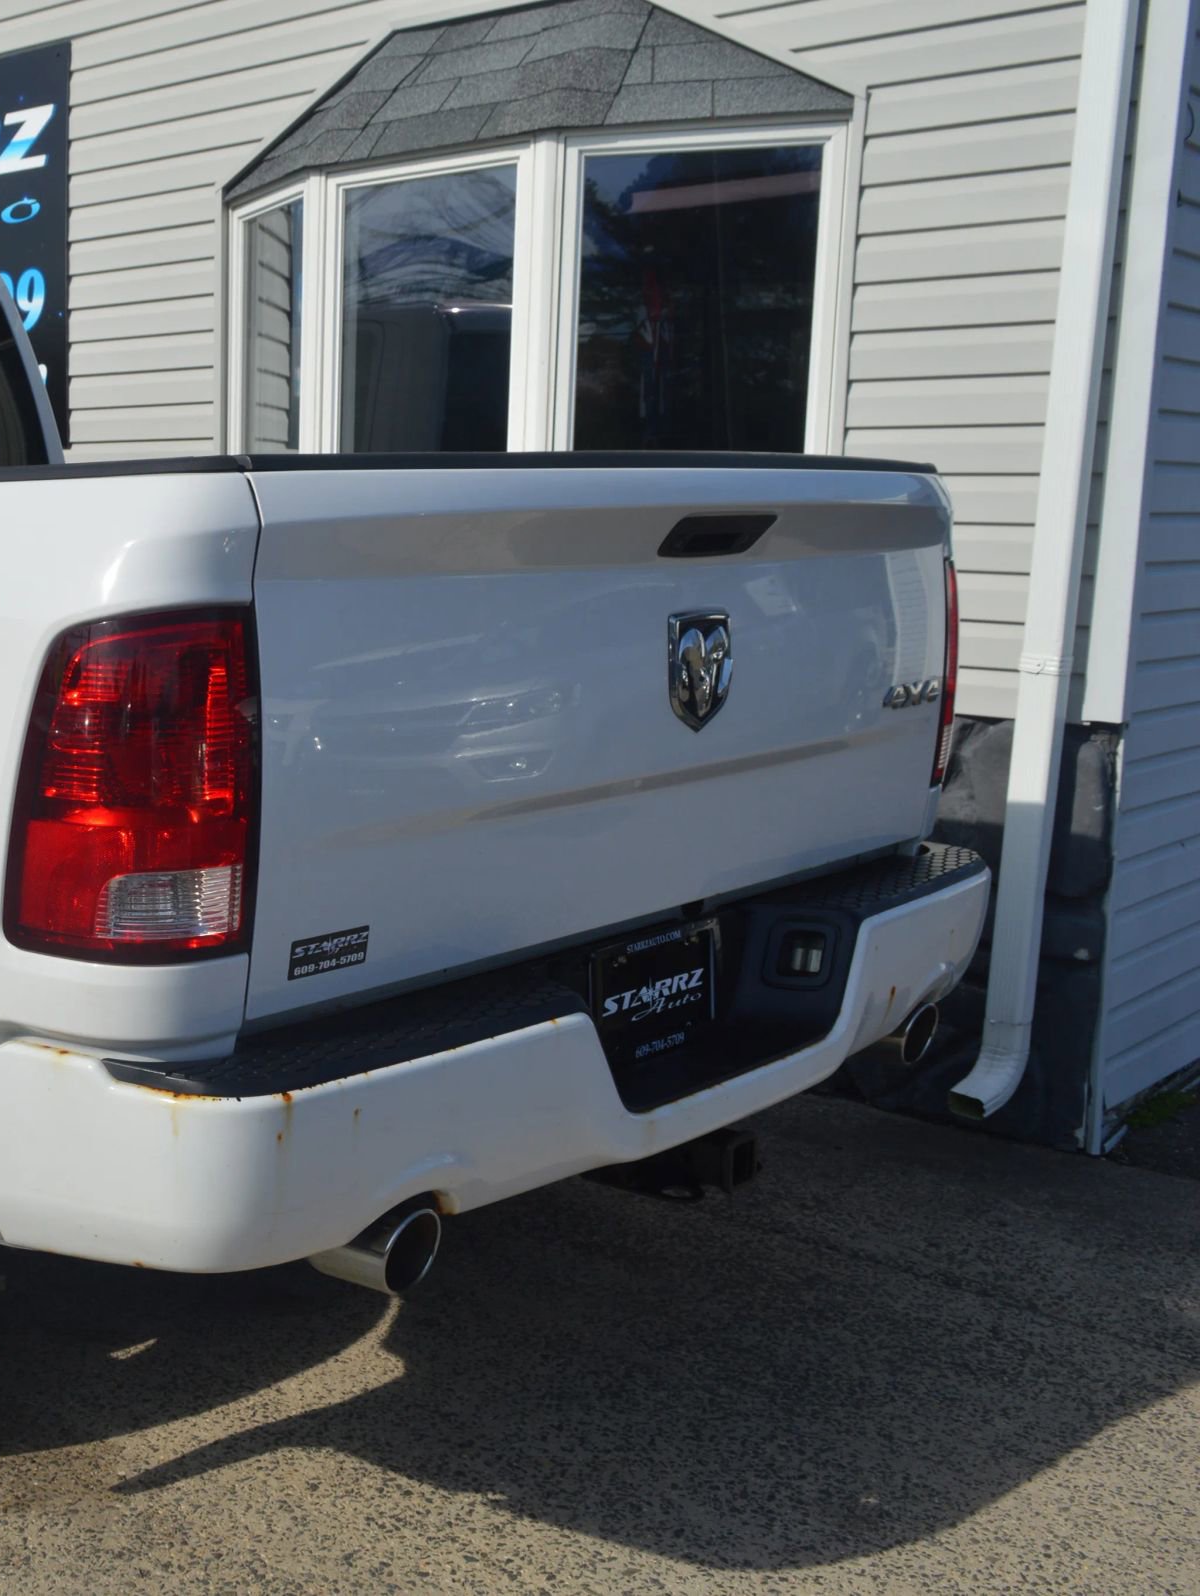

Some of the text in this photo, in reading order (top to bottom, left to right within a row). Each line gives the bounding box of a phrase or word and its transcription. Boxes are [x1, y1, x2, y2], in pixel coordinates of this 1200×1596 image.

[292, 932, 369, 959] STARRZ
[294, 952, 364, 975] 609-704-5709
[603, 968, 704, 1017] STARRZ
[631, 992, 703, 1021] Auto
